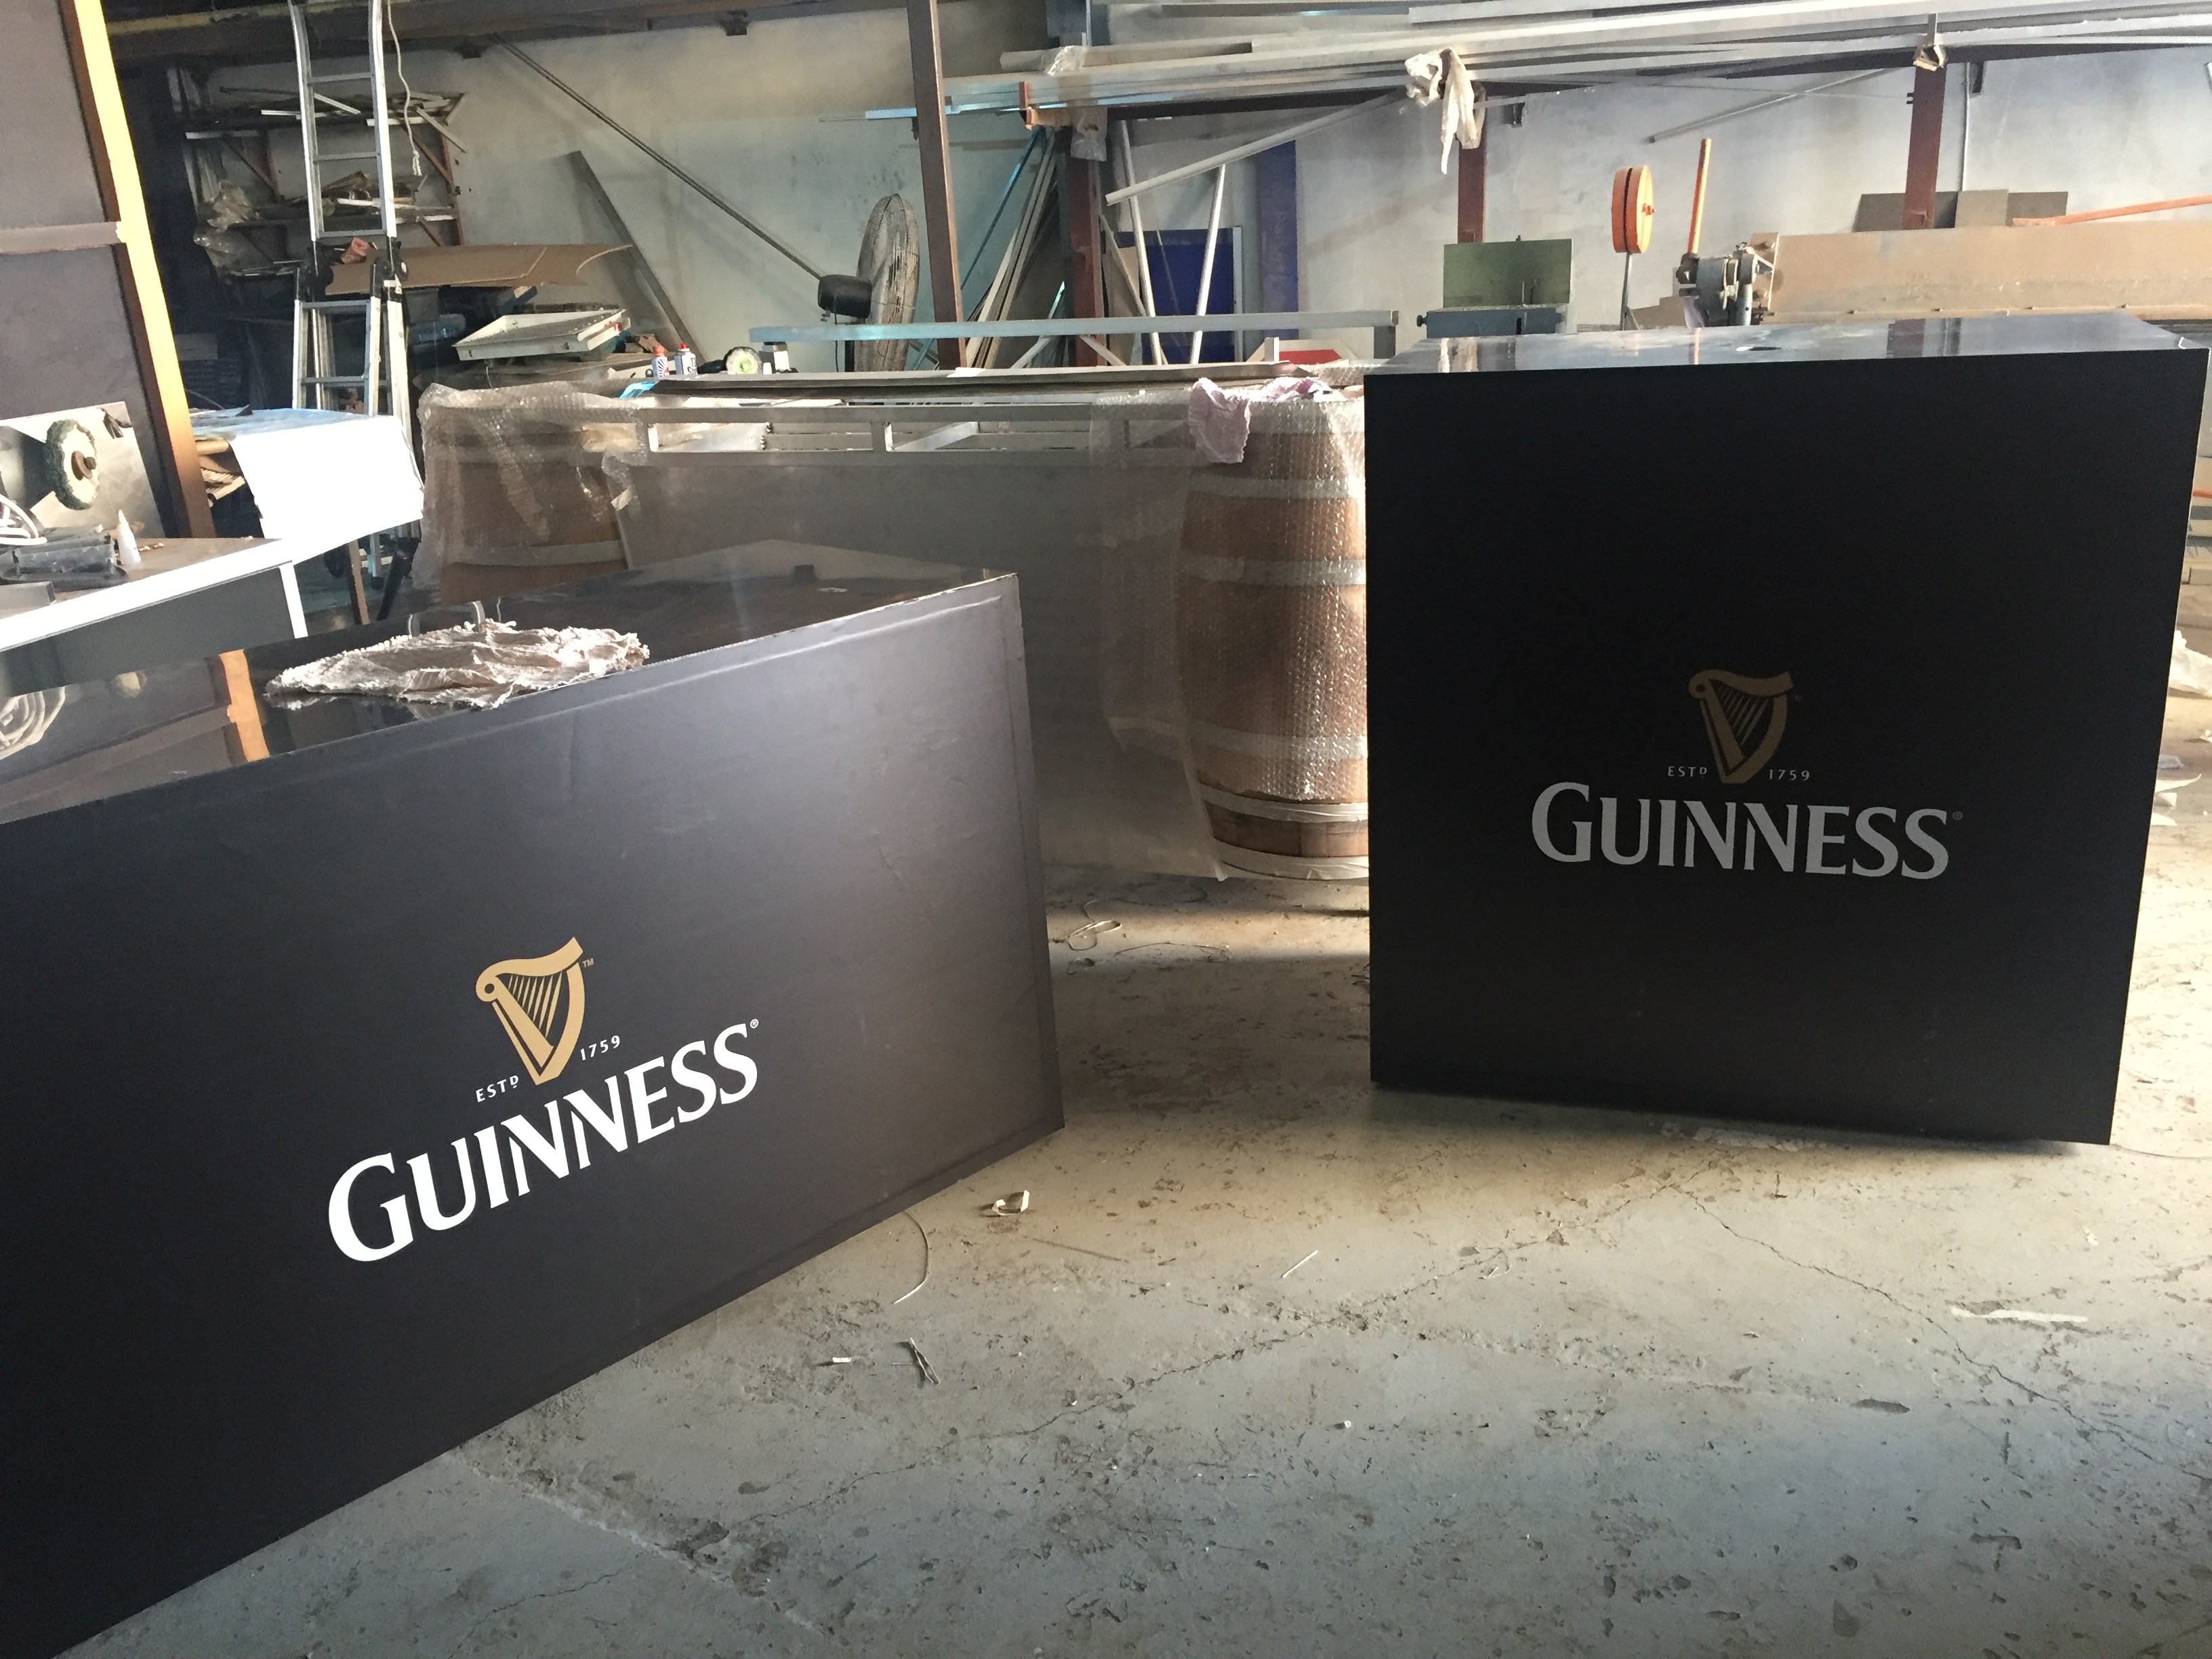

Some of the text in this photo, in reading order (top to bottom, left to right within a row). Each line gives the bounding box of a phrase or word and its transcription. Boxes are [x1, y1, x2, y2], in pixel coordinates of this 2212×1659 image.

[1667, 765, 1811, 781] ESTD 1759
[1531, 781, 1949, 880] GUINNESS
[475, 1035, 621, 1103] ESTD 1759
[328, 1023, 758, 1263] GUINNESS
